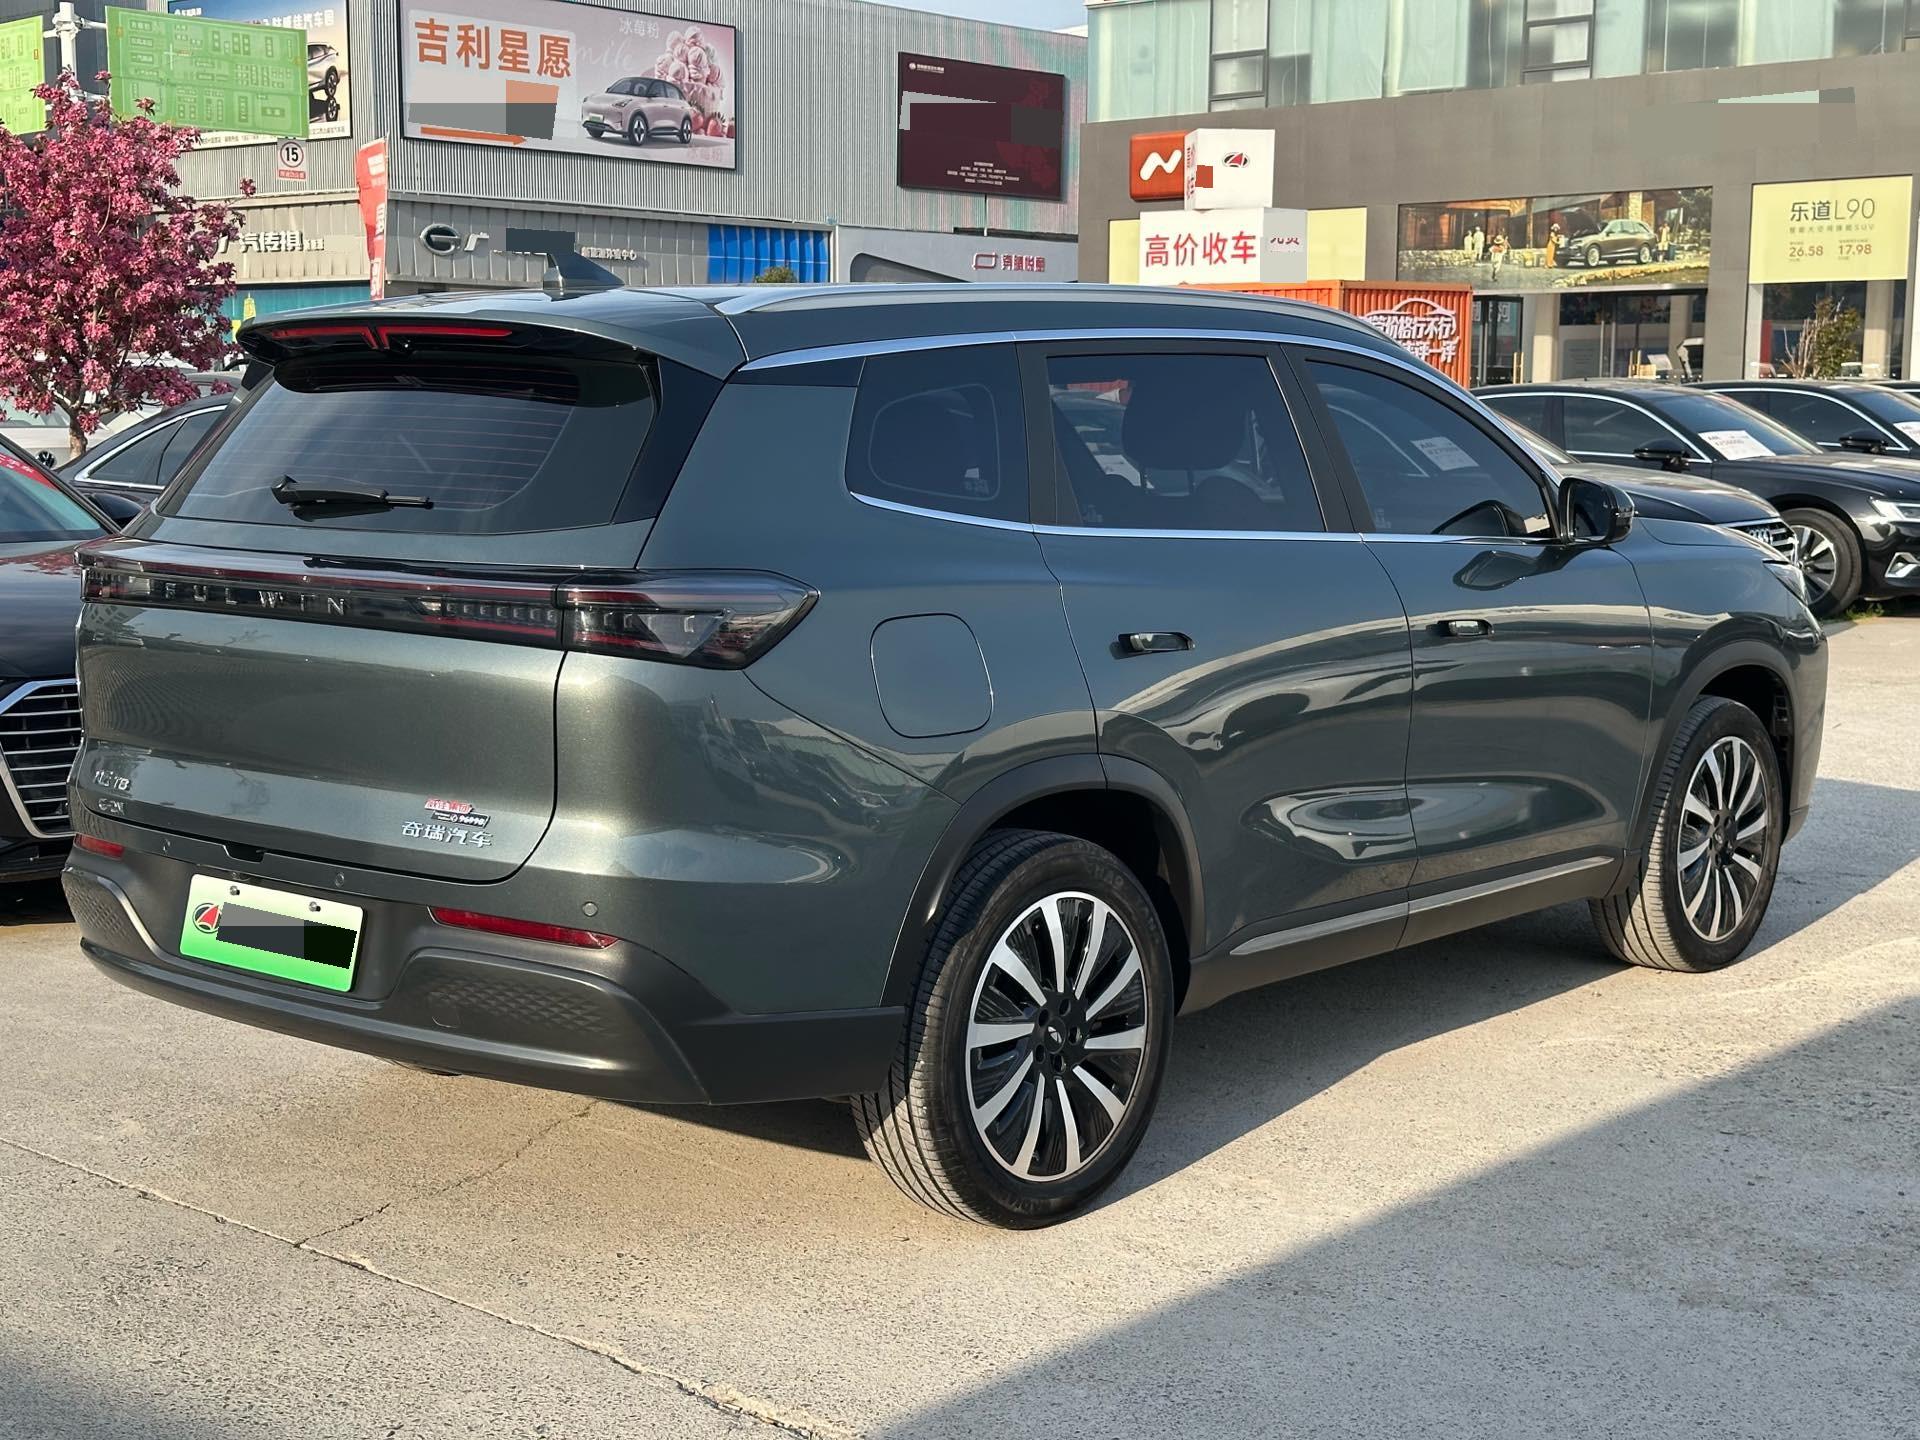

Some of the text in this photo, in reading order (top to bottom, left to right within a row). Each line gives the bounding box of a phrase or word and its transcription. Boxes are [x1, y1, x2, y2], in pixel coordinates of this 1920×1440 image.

[414, 18, 571, 79] 吉利星愿
[285, 147, 299, 162] 15
[1790, 198, 1875, 221] 乐道L90
[1145, 231, 1256, 267] 高价收车
[1789, 245, 1824, 257] 26.58
[1839, 243, 1872, 256] 17.98
[402, 821, 493, 848] 奇瑞汽车
